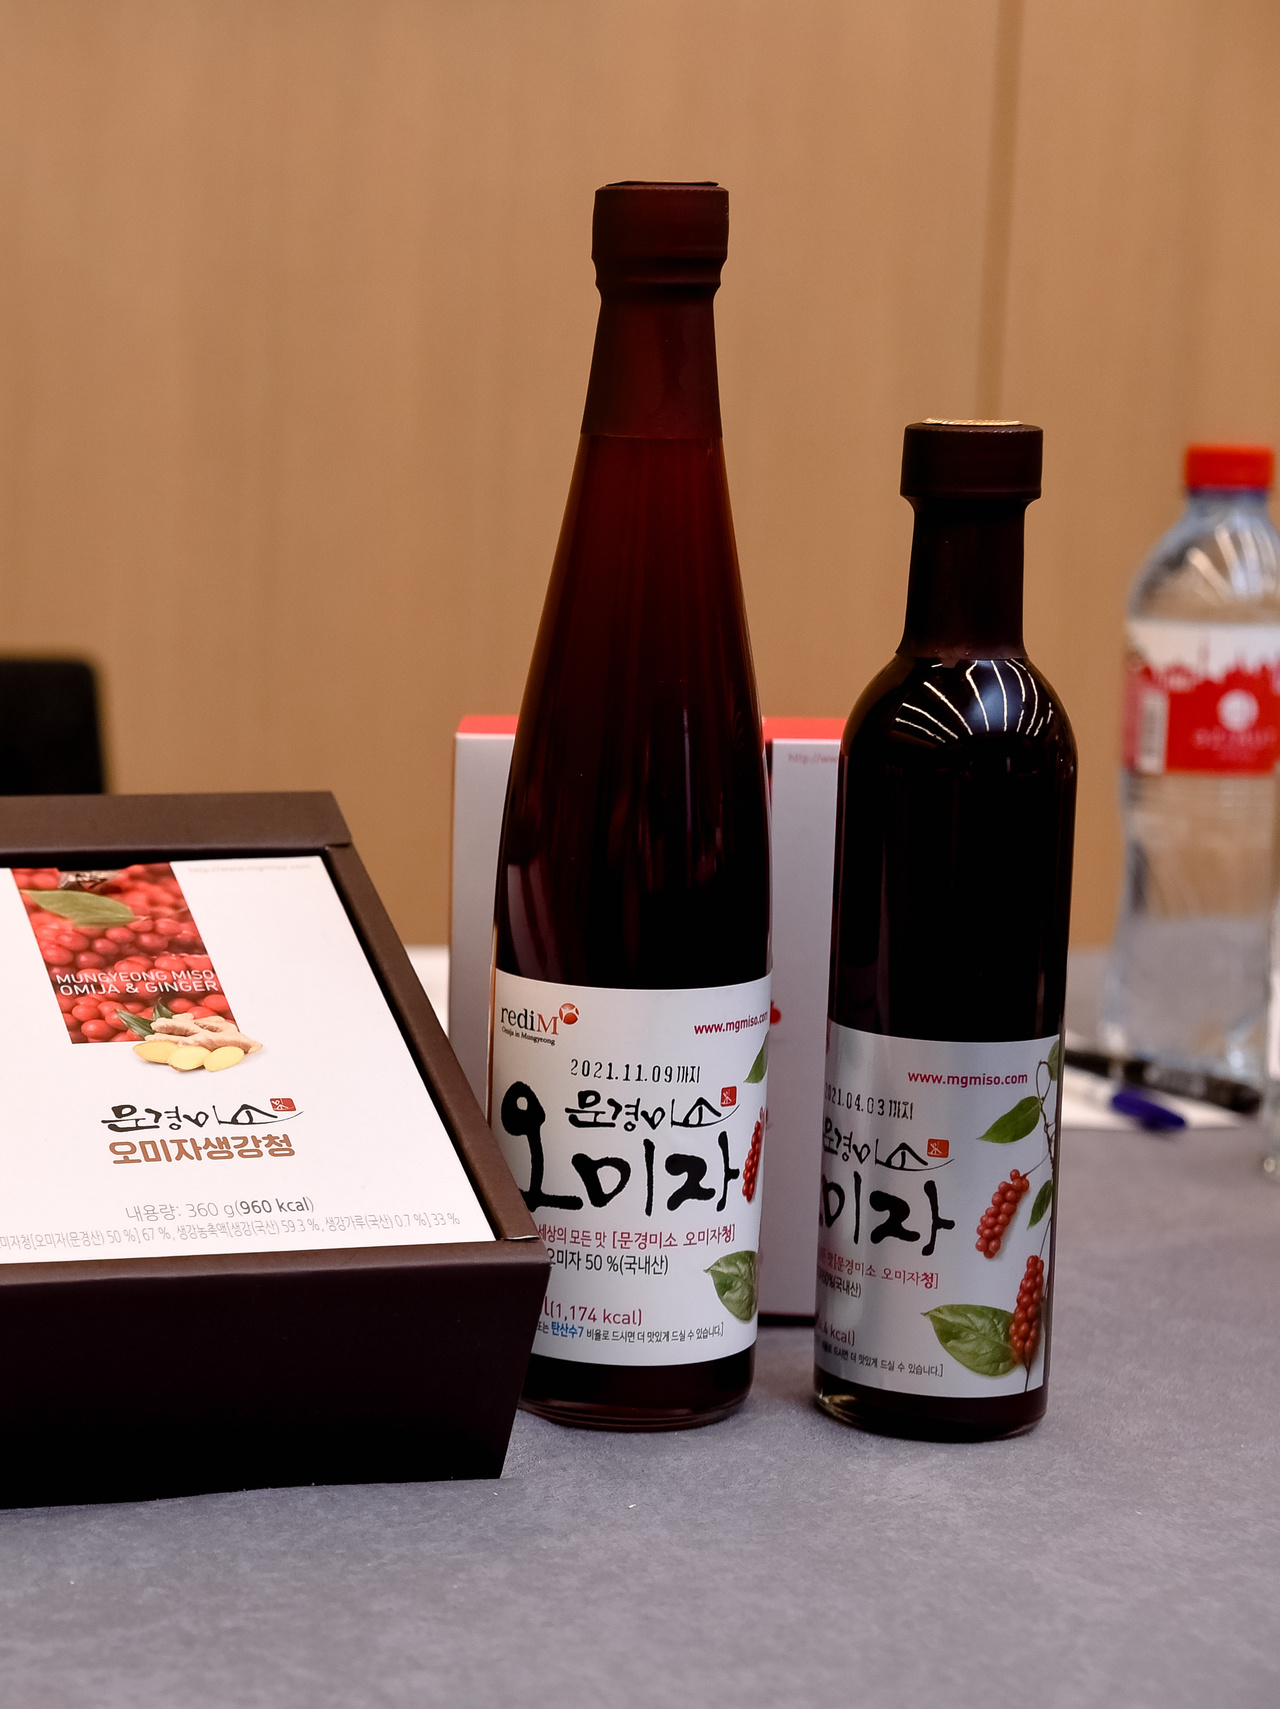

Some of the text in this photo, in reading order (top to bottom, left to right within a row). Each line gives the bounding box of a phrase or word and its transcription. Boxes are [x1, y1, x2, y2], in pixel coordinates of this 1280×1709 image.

[56, 969, 215, 984] MUNGYEONG MISO
[60, 980, 219, 995] OMIJA & GINGER
[500, 1007, 559, 1036] rediM
[693, 1011, 768, 1035] www.mgmiso.com
[907, 1072, 1028, 1089] www.mgmiso.com
[101, 1103, 304, 1133] 문경미소
[565, 1090, 740, 1132] 문경미소
[109, 1133, 296, 1164] 오미자생강청
[501, 1081, 740, 1216] 오미자
[125, 1196, 315, 1223] 내용량: 360 g(960 kcal)
[819, 1171, 956, 1257] 미자
[106, 1230, 122, 1244] 50
[123, 1228, 141, 1244] %]
[142, 1227, 155, 1241] 67
[281, 1218, 306, 1233] 59.3
[394, 1213, 411, 1228] 0.7
[413, 1212, 432, 1228] %]
[433, 1212, 447, 1225] 33
[447, 1212, 461, 1225] %
[570, 1229, 593, 1248] 모든
[595, 1231, 607, 1248] 맛
[612, 1230, 679, 1250] [문경미소
[683, 1223, 736, 1246] 오미자청]
[585, 1254, 603, 1271] 50
[606, 1254, 669, 1276] %(국내산)
[881, 1267, 939, 1289] 오미자청]
[543, 1296, 642, 1326] l(1,174 kcal)
[551, 1321, 584, 1339] 탄산수7
[586, 1329, 610, 1341] 비율로
[611, 1331, 635, 1342] 드시면
[637, 1331, 645, 1342] 더
[647, 1330, 670, 1343] 맛있게
[671, 1329, 686, 1342] 드실
[687, 1329, 695, 1341] 수
[897, 1362, 905, 1373] 수
